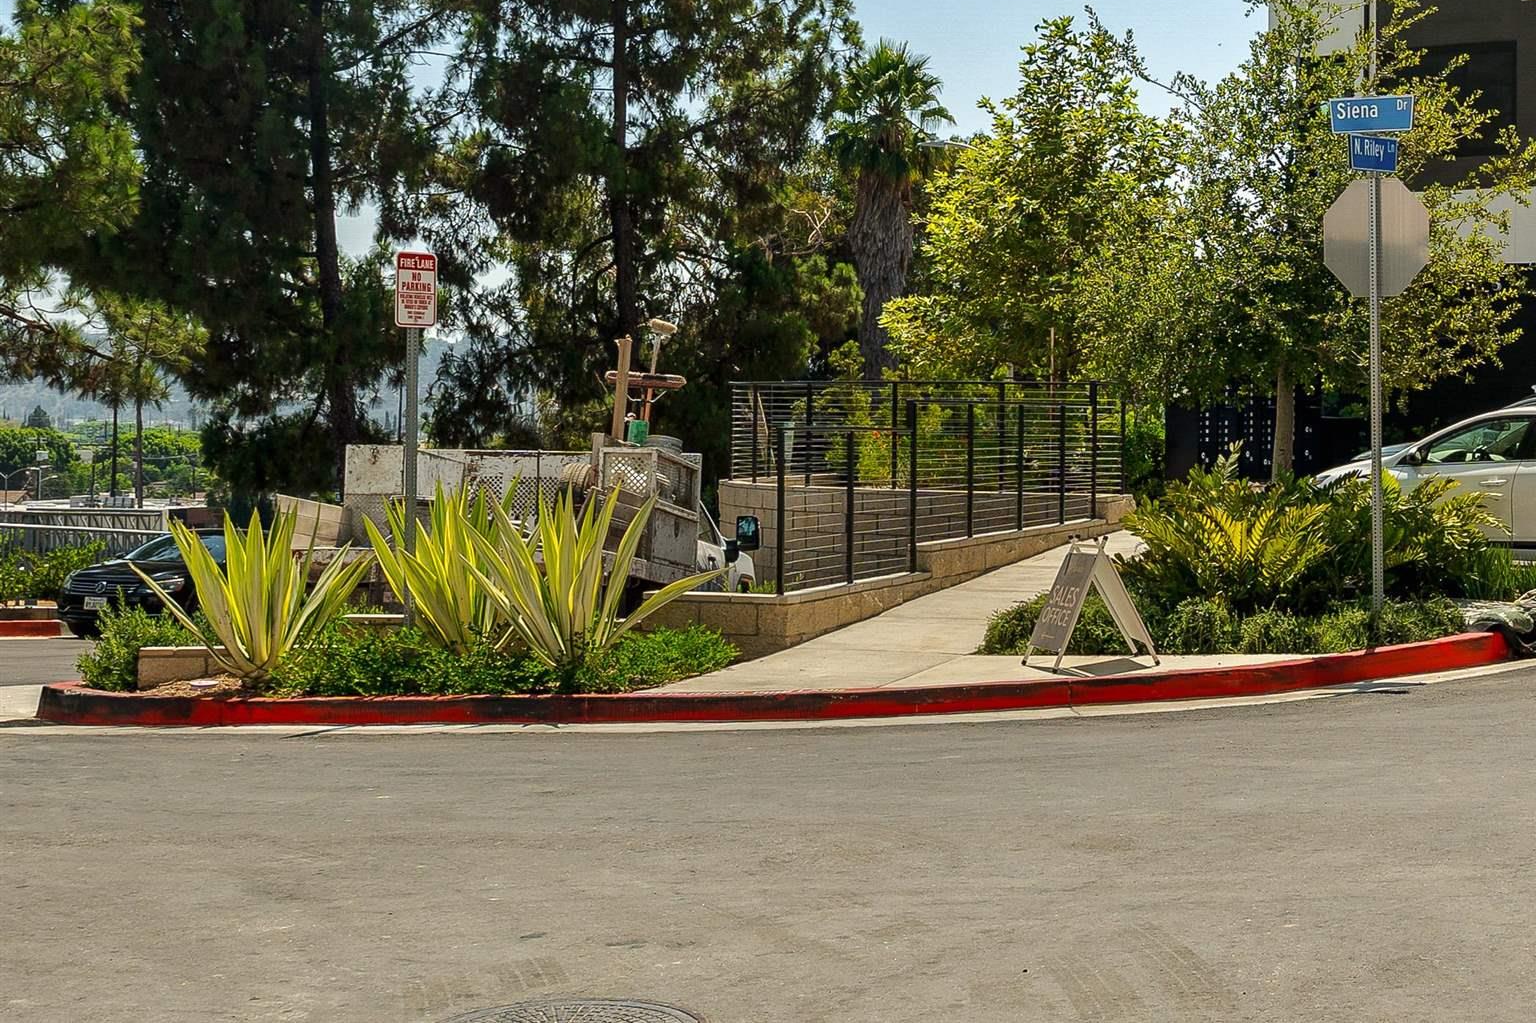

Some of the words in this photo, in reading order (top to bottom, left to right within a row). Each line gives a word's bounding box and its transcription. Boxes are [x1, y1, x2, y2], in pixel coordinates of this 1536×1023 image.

[1337, 103, 1378, 119] Siena
[1396, 99, 1408, 111] Dr
[1354, 138, 1363, 155] N.
[1364, 139, 1385, 162] Riley
[1387, 142, 1394, 152] Ln
[400, 258, 416, 268] FIRE
[417, 259, 434, 269] LANE
[412, 272, 421, 281] NO
[402, 282, 431, 292] PARKING
[1050, 585, 1080, 607] SALES
[1042, 607, 1071, 626] OFFICE
